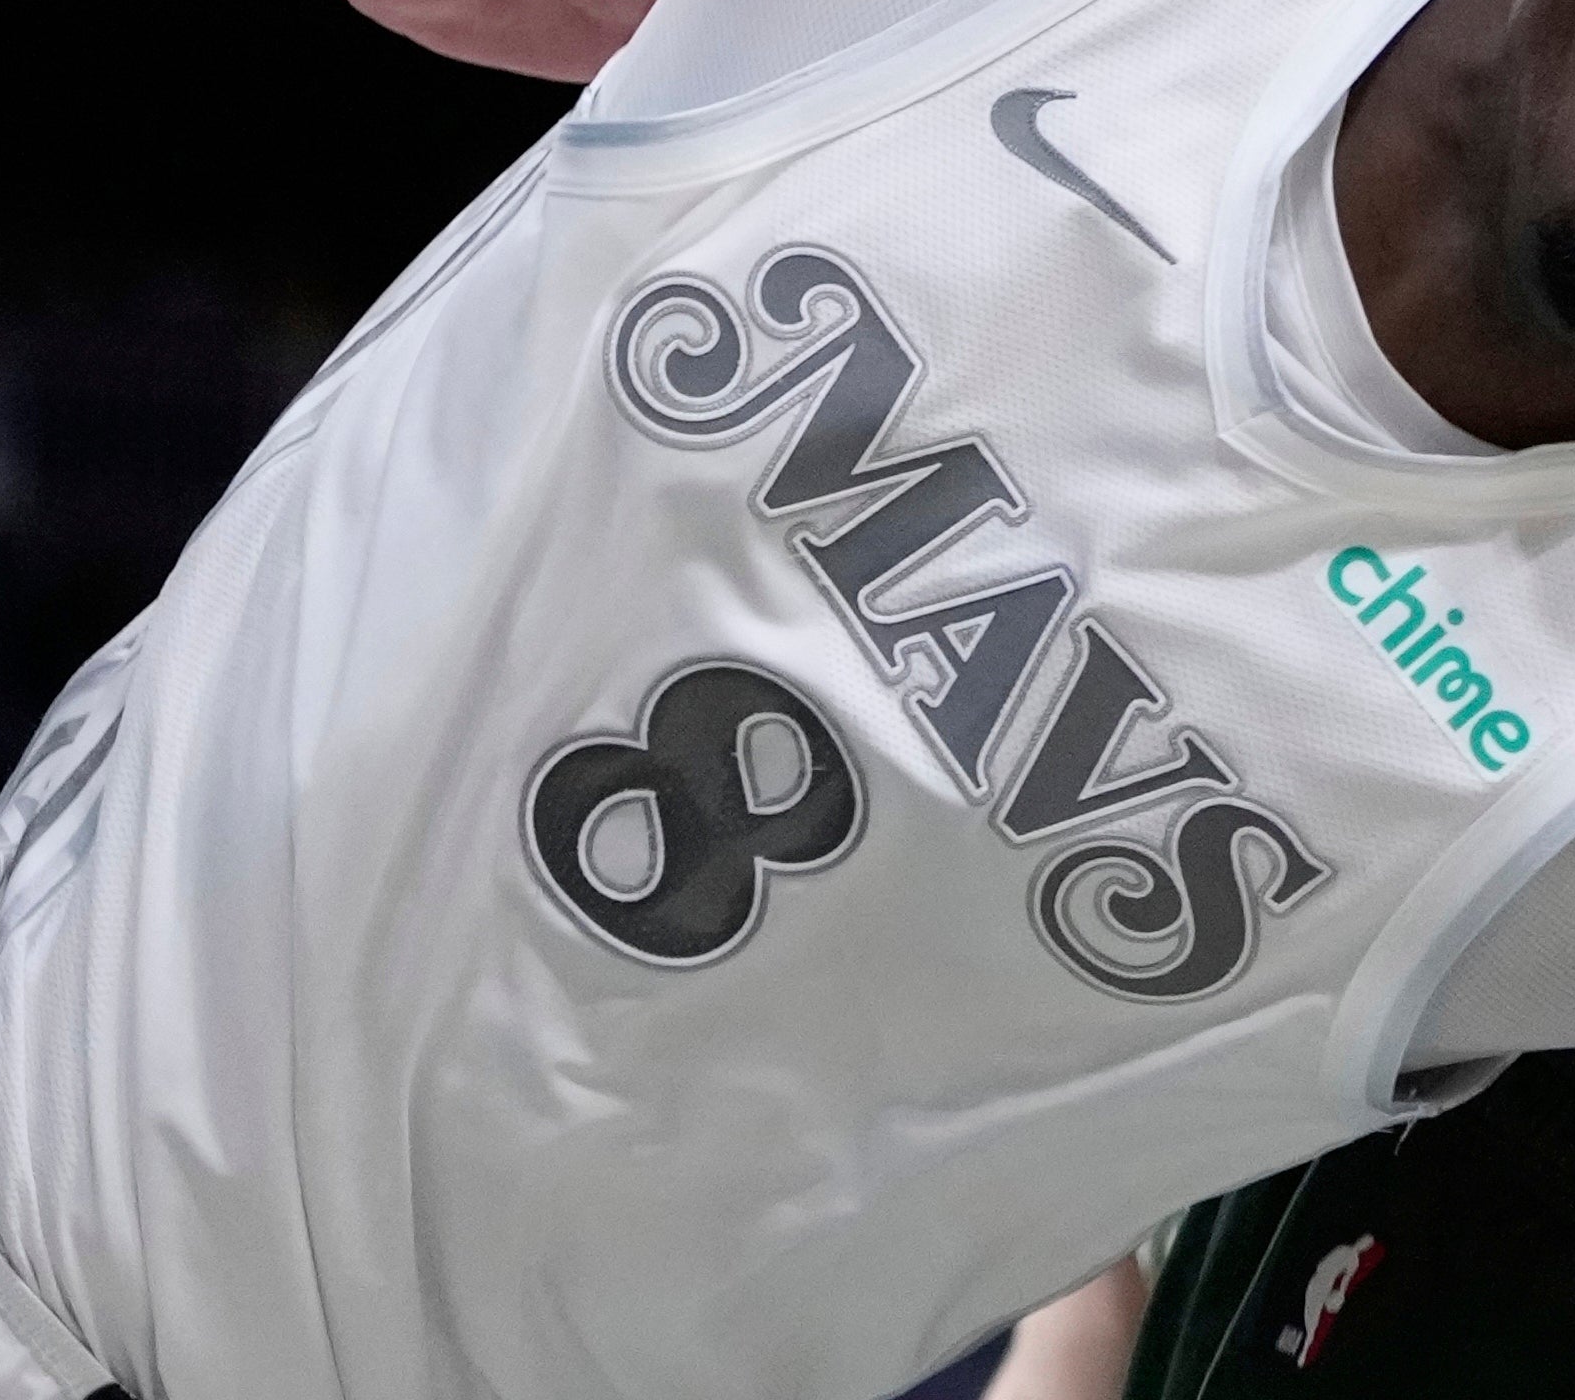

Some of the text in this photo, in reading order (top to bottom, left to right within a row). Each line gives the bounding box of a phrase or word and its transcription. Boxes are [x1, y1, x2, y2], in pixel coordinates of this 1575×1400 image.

[604, 240, 1333, 1005] MAVS
[1325, 542, 1533, 774] chime
[522, 656, 871, 970] 8
